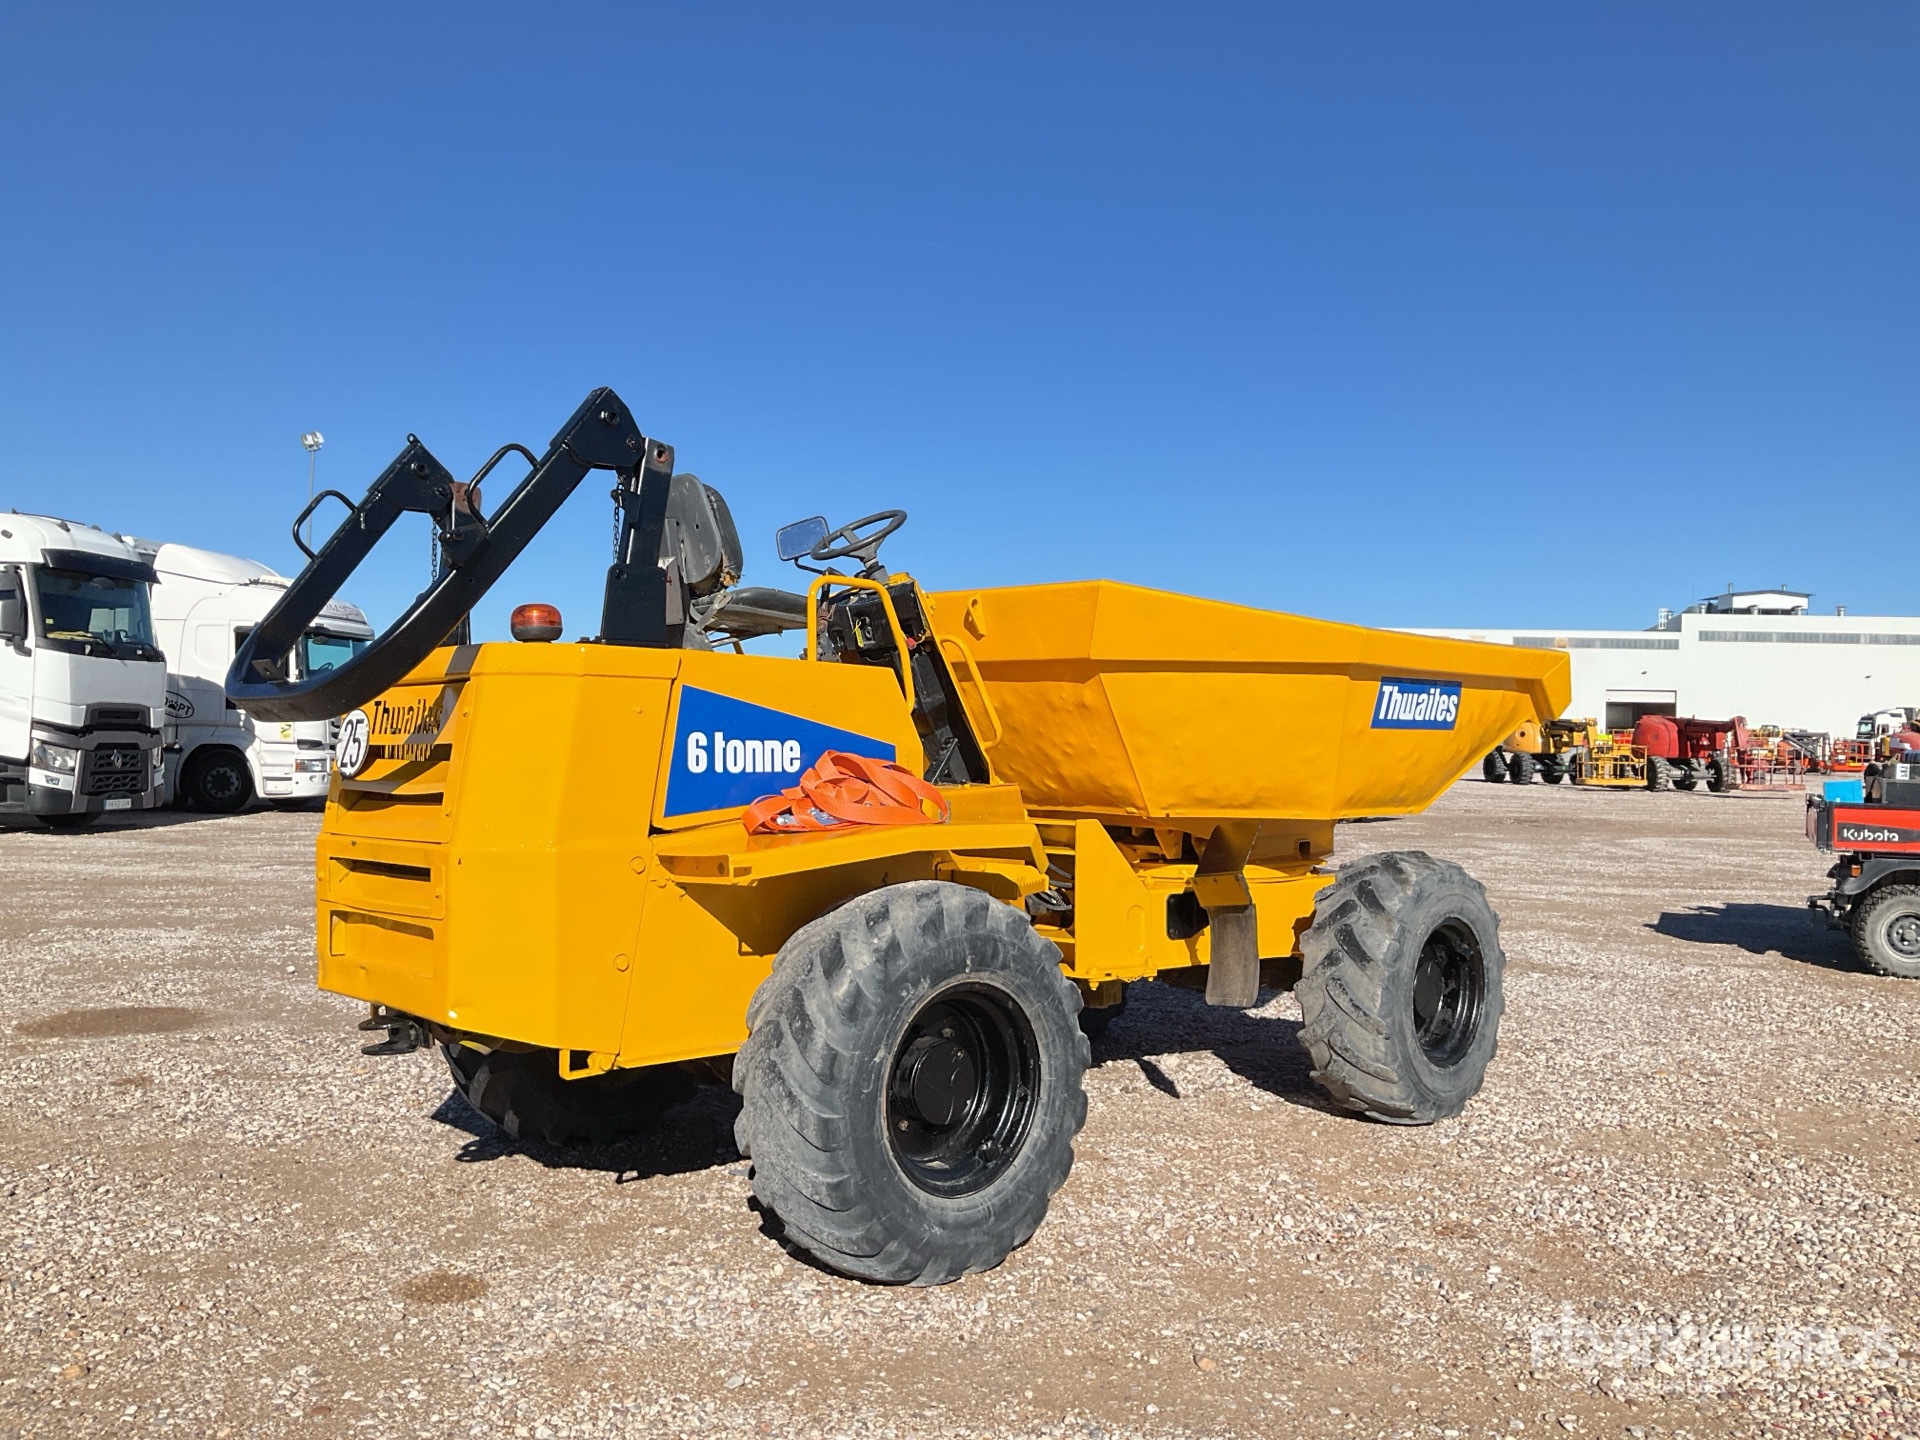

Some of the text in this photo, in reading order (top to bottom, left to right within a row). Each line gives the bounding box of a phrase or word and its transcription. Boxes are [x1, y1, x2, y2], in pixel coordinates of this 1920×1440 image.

[371, 698, 442, 735] Thwaites
[1378, 685, 1458, 722] Thwaites
[340, 718, 365, 768] 25
[687, 731, 801, 774] 6 tonne
[1843, 828, 1899, 841] Kubota
